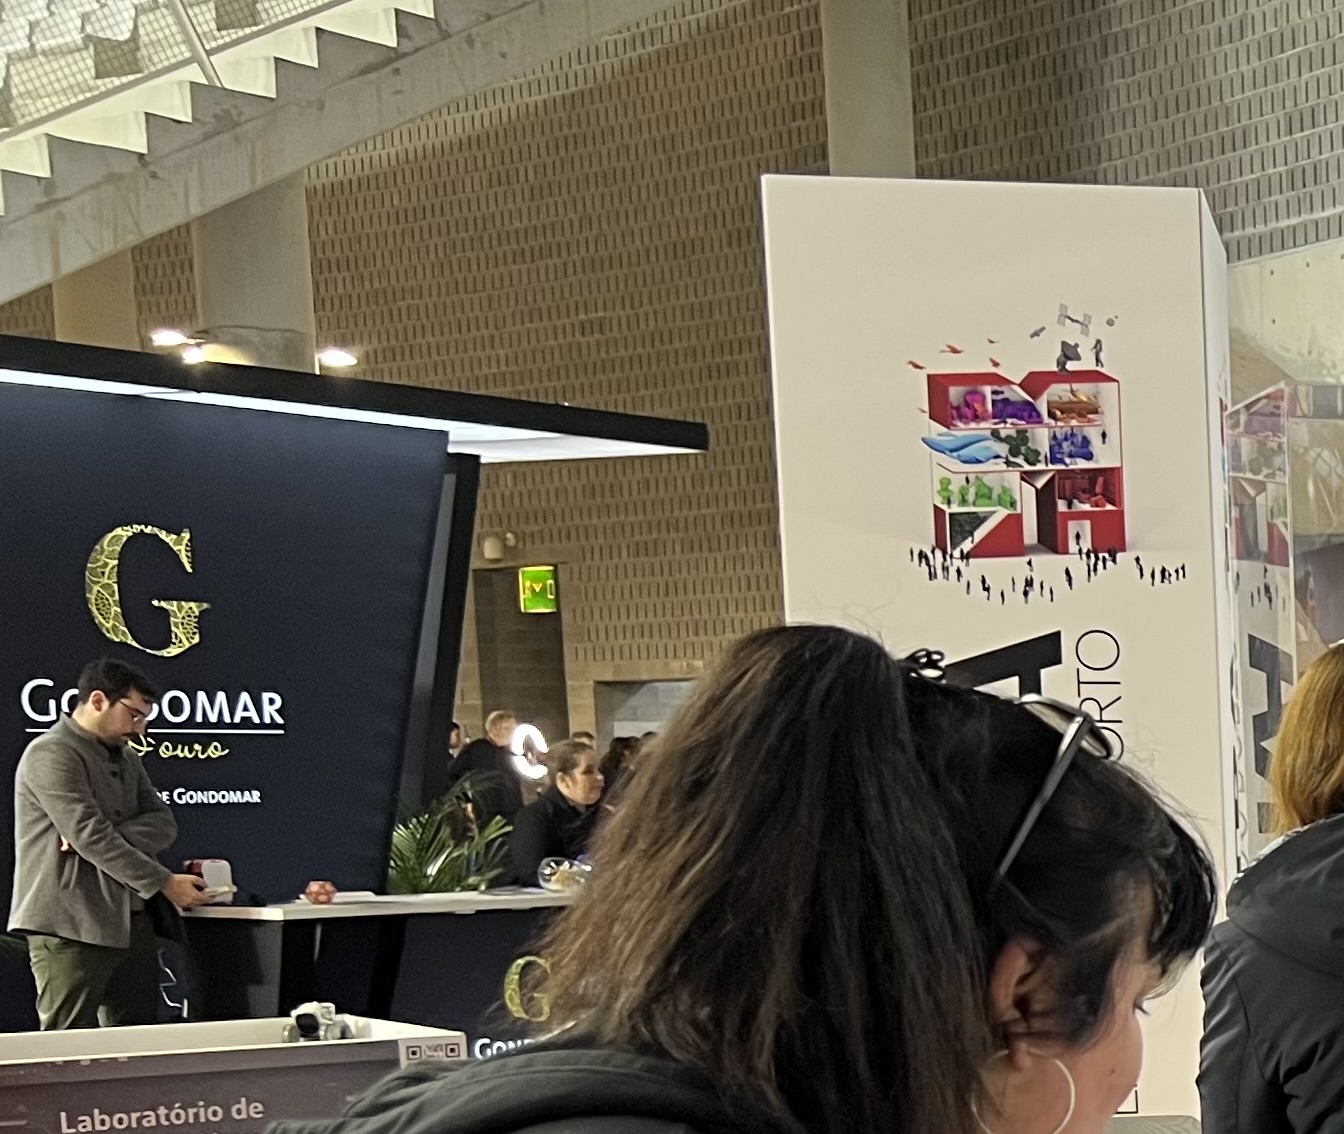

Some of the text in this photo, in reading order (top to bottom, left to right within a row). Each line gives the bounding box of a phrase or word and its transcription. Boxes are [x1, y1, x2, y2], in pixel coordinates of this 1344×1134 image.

[85, 523, 211, 657] G
[173, 787, 261, 805] GONDOMAR
[60, 1097, 265, 1134] Laboratório de
